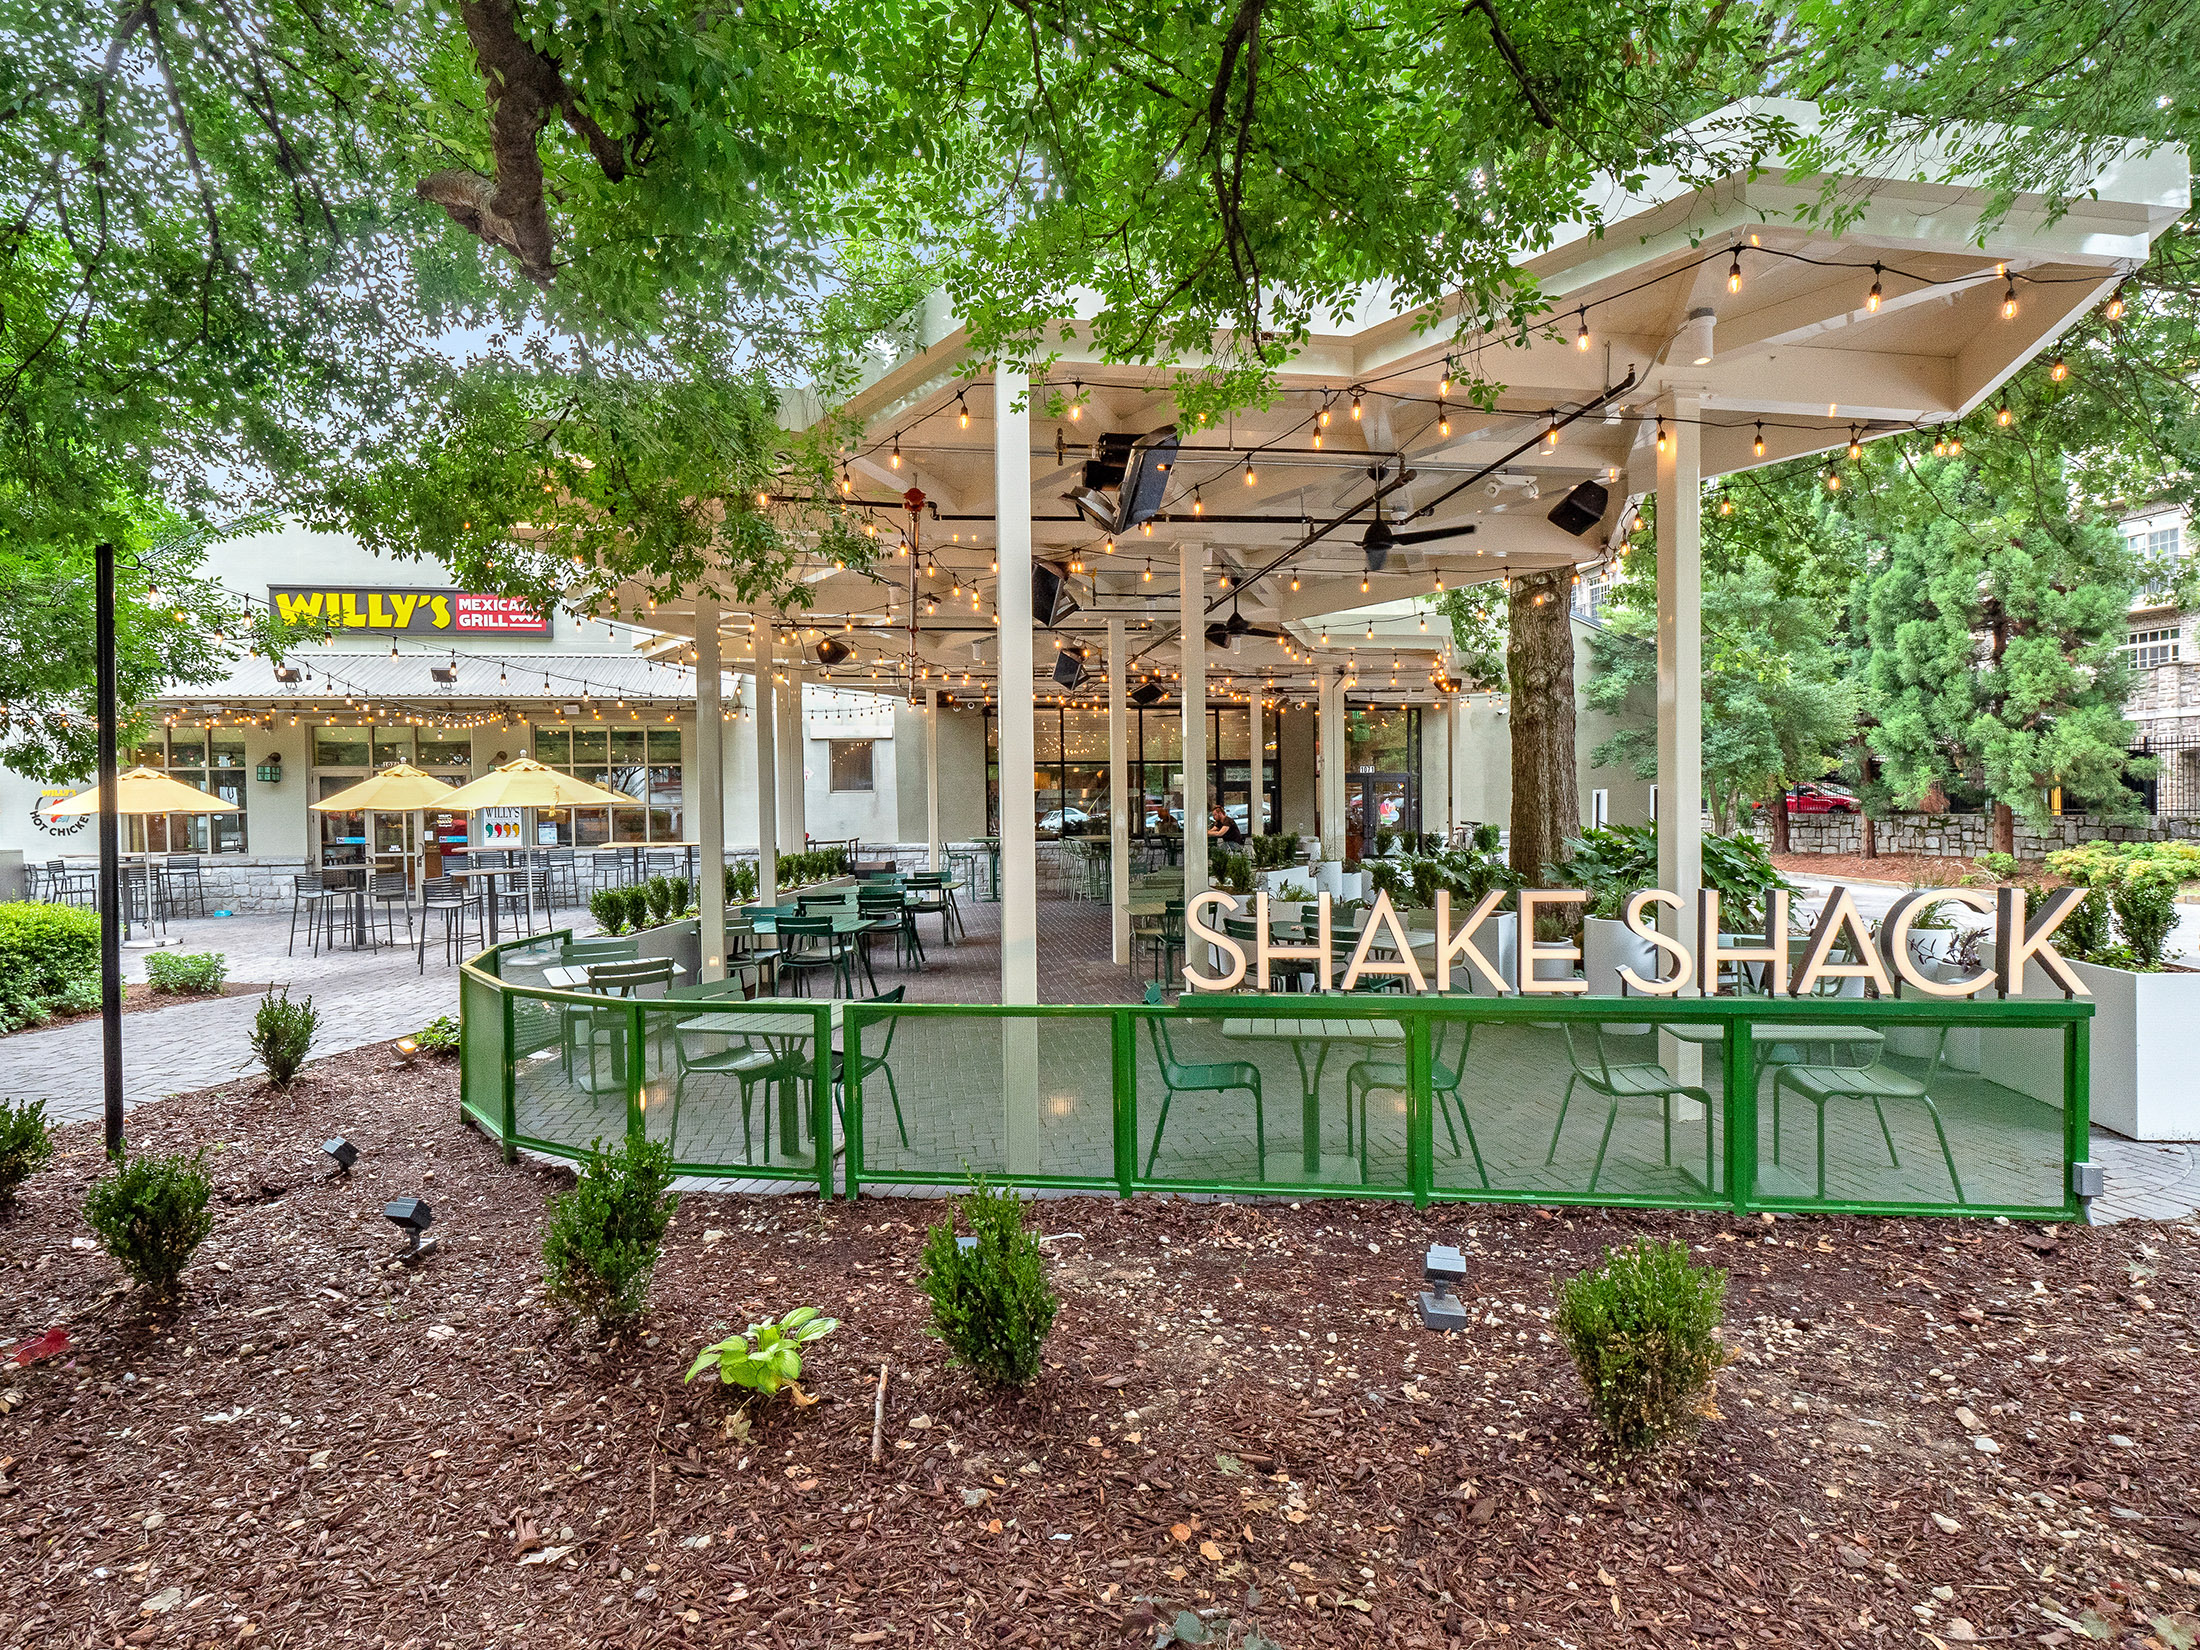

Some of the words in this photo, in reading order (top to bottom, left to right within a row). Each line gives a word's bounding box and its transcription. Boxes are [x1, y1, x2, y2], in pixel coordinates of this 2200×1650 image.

[275, 592, 452, 629] WILLY'S
[458, 613, 509, 627] GRILL
[41, 789, 77, 797] WILLY'S
[29, 810, 48, 831] HOT
[49, 813, 90, 836] CHICKE
[1181, 888, 1589, 992] SHAKE
[1614, 886, 2093, 997] SHACK
